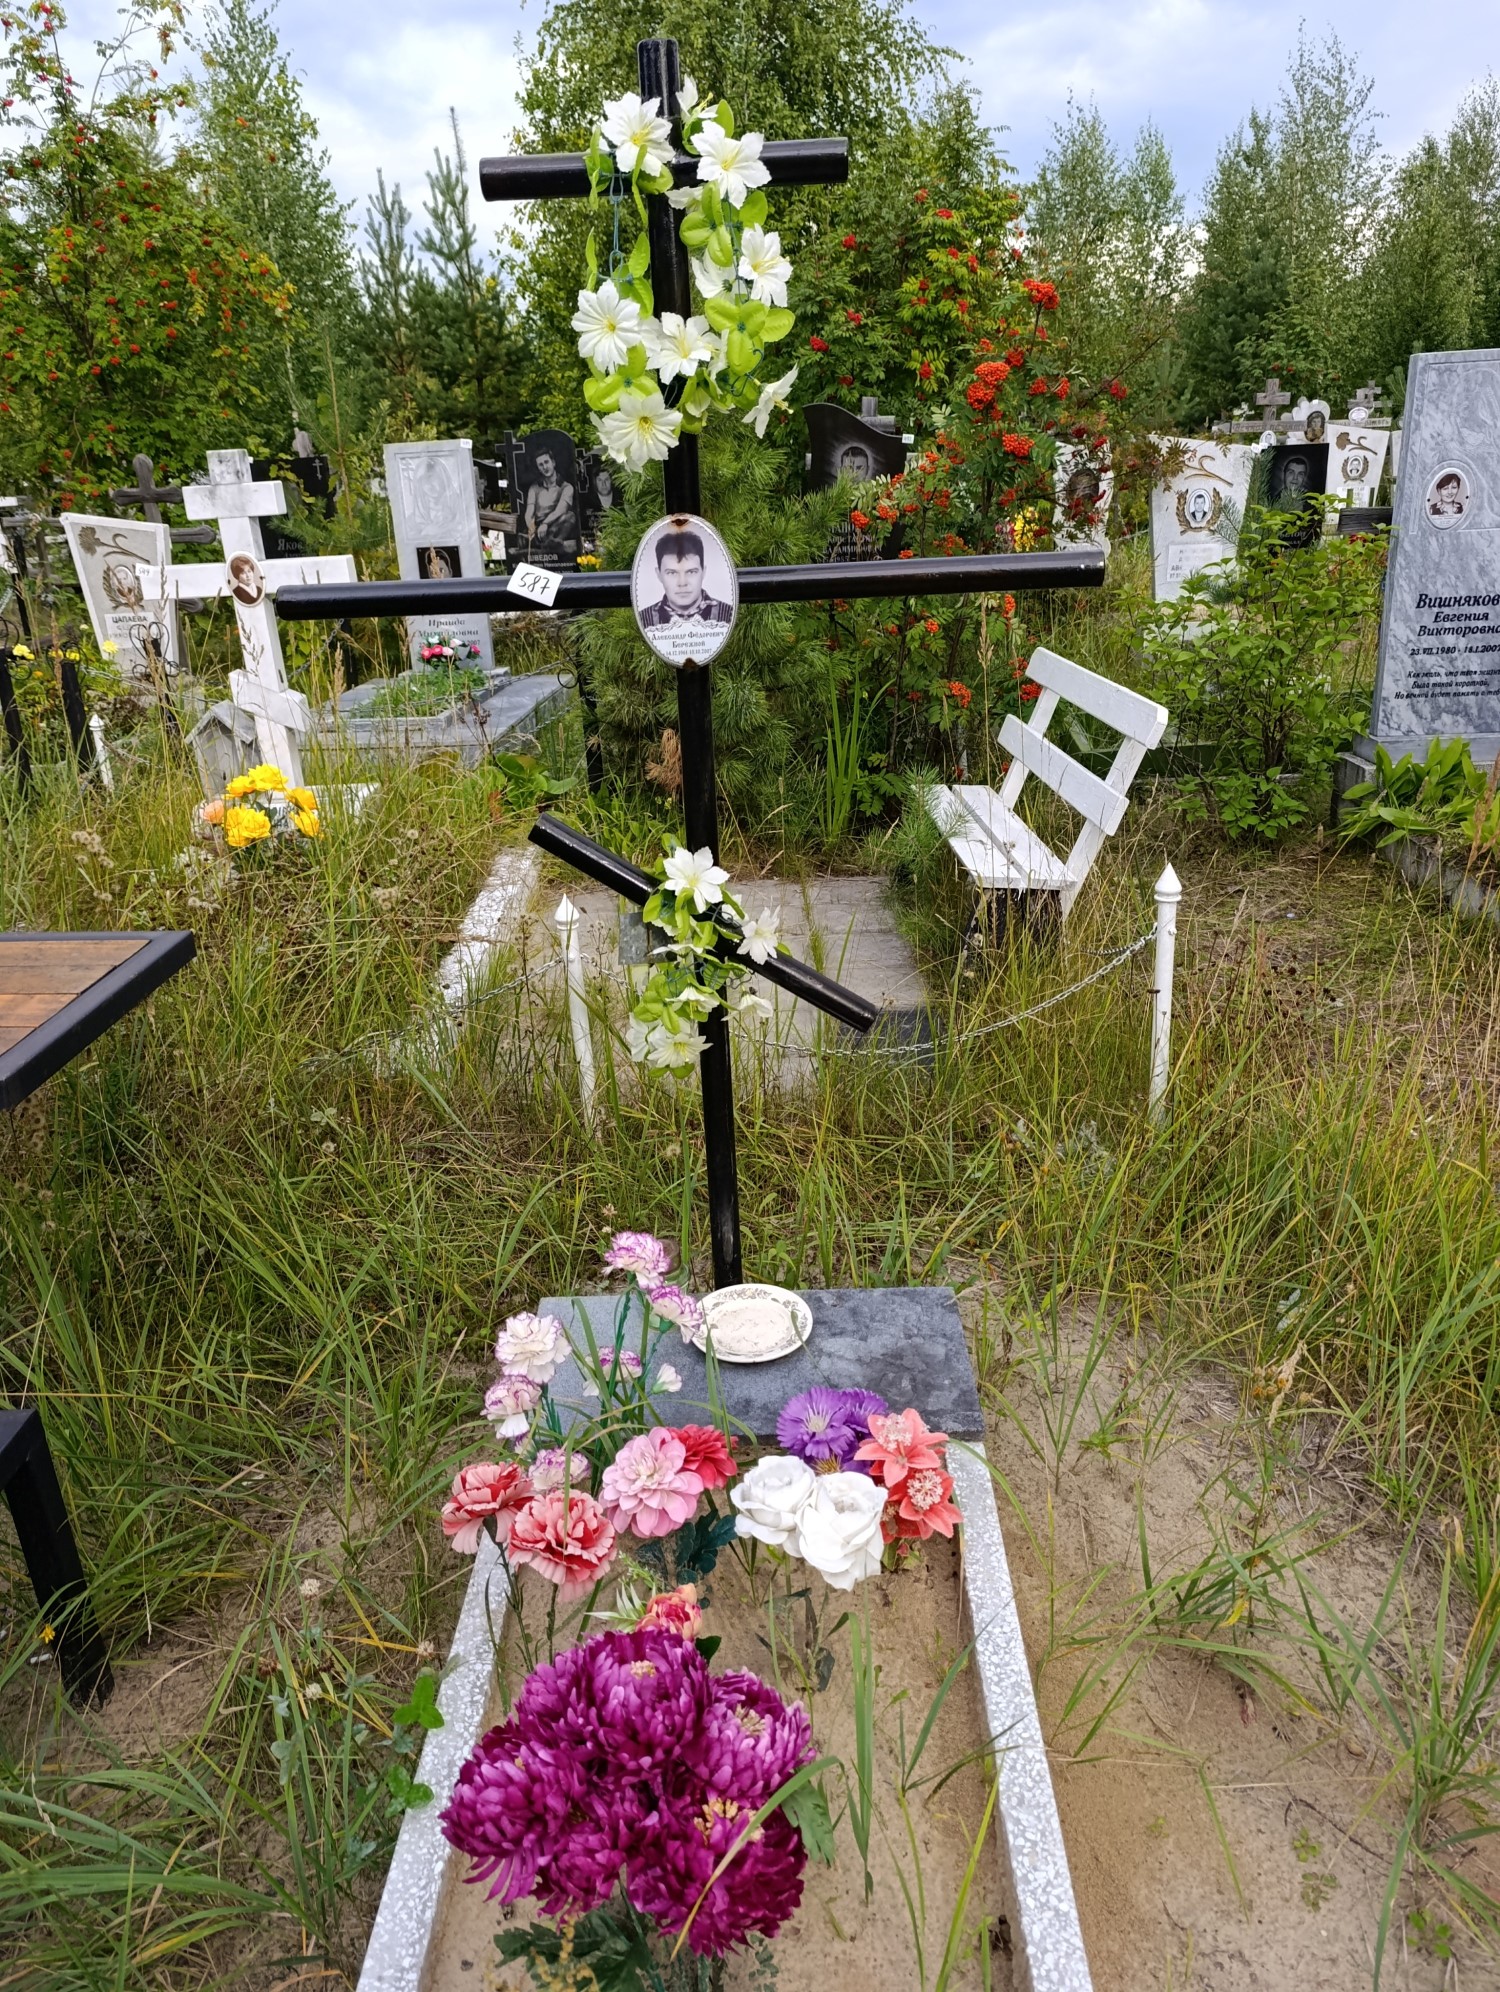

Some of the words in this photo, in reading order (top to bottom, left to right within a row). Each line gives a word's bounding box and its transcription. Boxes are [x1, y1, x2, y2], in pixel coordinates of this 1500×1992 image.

[528, 554, 558, 562] ШВЕДОВ
[517, 572, 551, 595] 587
[1433, 611, 1490, 623] Евгения
[672, 640, 706, 649] Бережной
